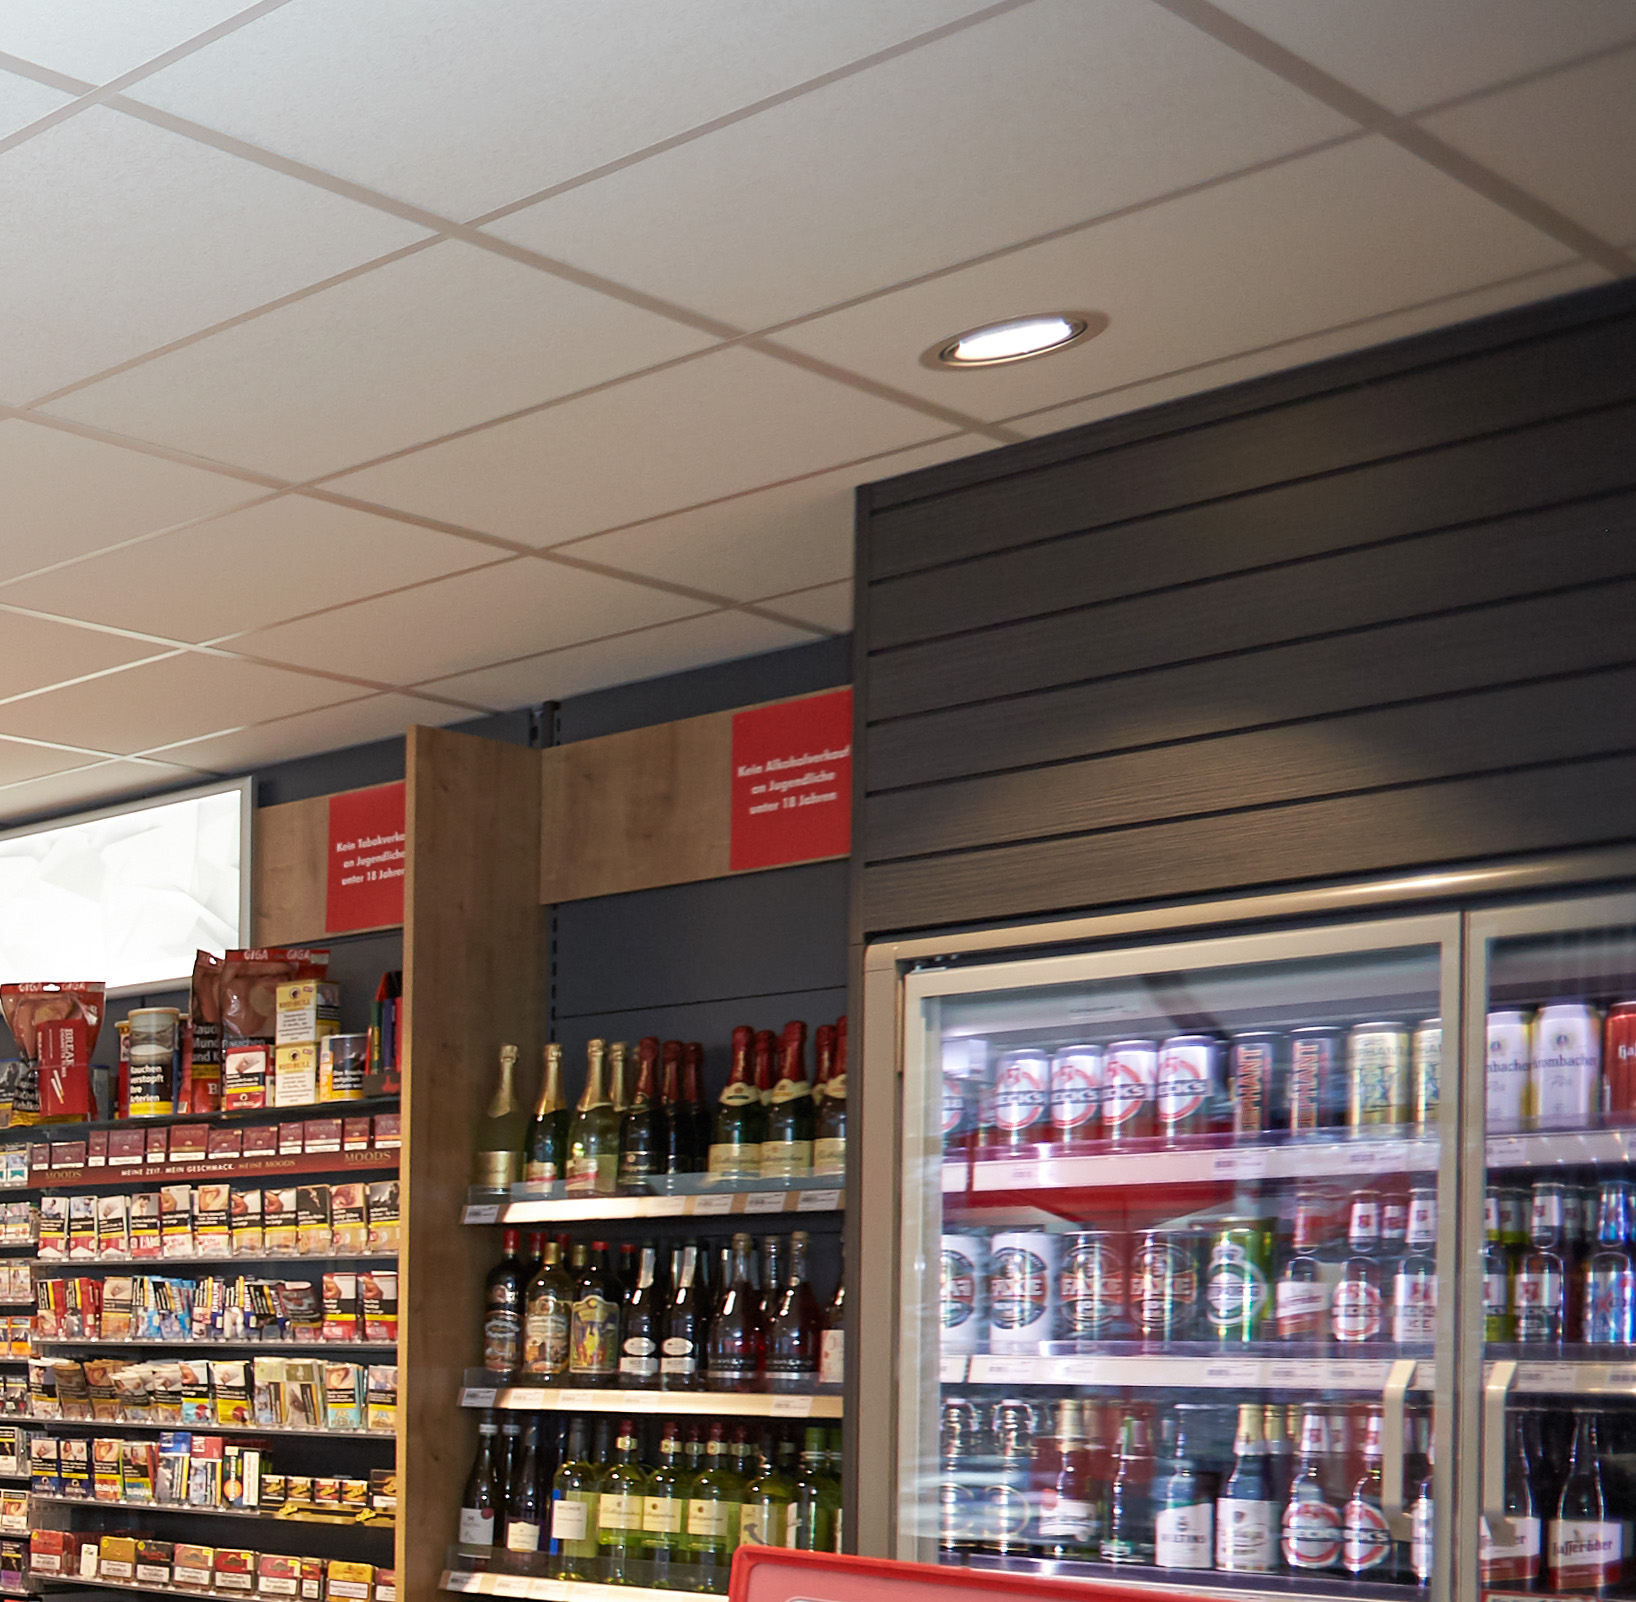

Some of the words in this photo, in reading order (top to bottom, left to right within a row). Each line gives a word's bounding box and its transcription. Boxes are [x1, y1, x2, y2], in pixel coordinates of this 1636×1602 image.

[738, 764, 762, 777] Kein
[765, 744, 851, 772] Alkoholverkauf
[752, 785, 766, 794] an
[769, 770, 835, 792] Jugendliche
[750, 802, 779, 814] unter
[783, 796, 796, 808] 18
[799, 792, 837, 806] Jahren
[337, 842, 355, 853] Kein
[358, 831, 405, 849] Tabakverka
[344, 860, 354, 868] an
